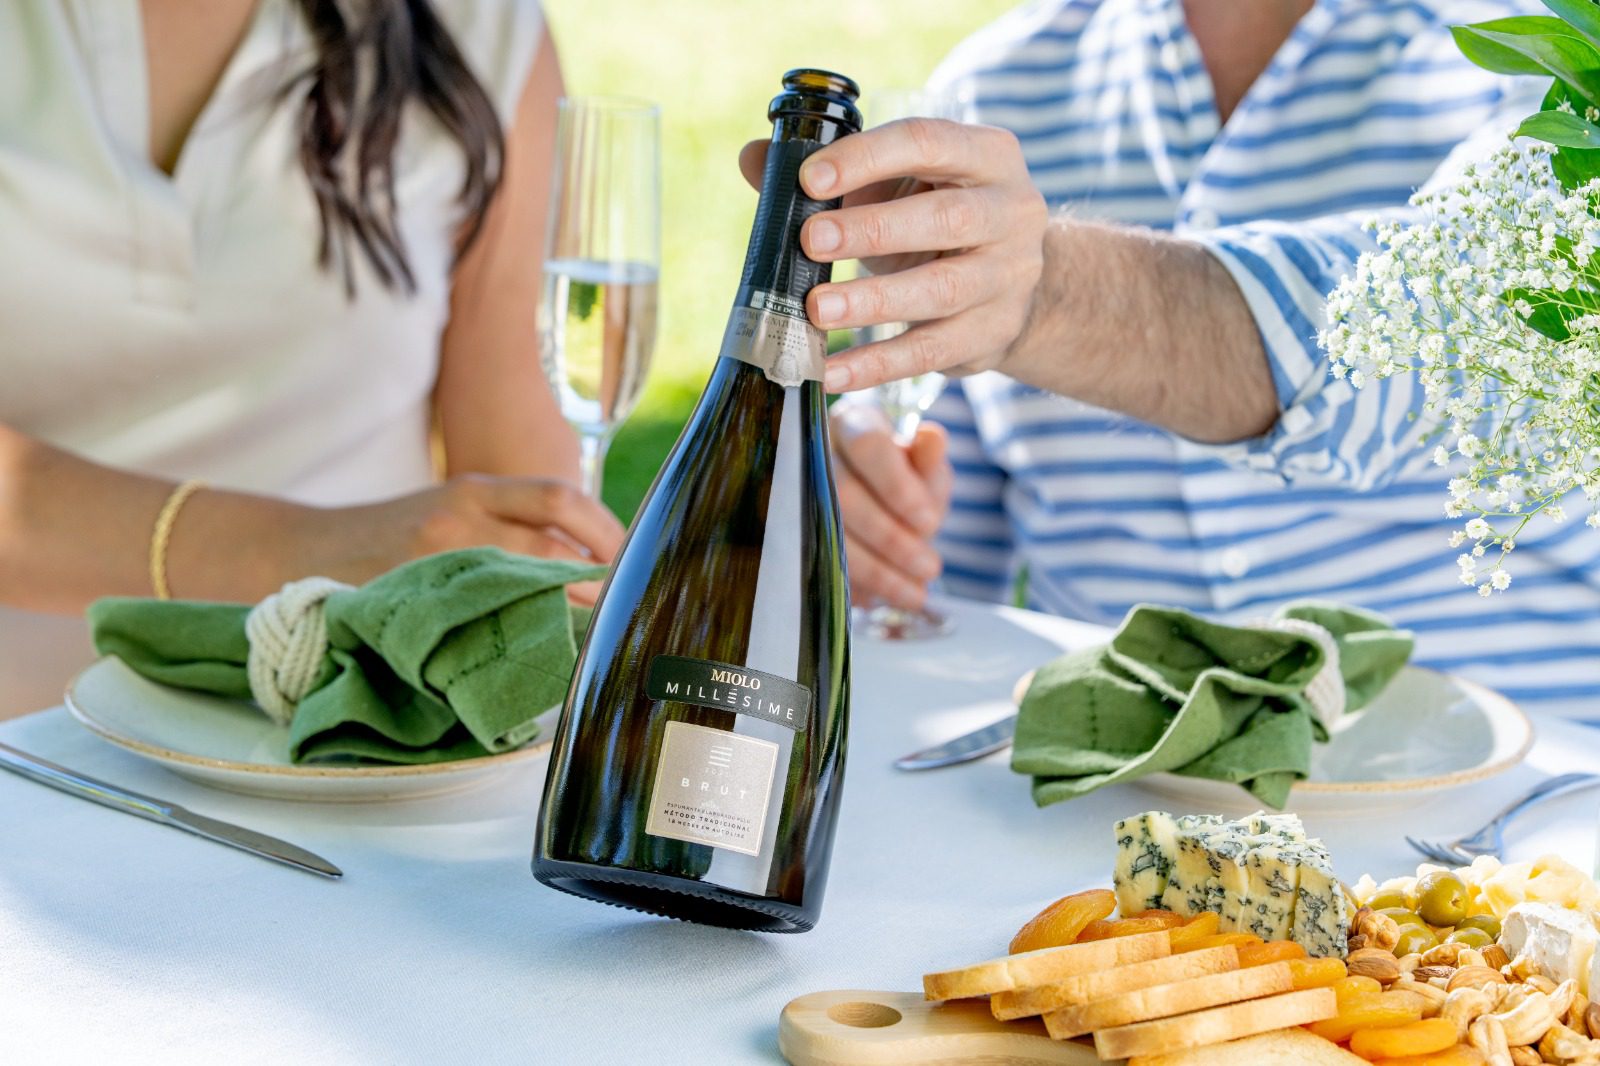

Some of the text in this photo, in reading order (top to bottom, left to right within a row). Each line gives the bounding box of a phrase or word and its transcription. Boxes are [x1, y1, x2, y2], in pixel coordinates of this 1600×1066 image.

[765, 301, 782, 312] VALE
[783, 307, 798, 315] DOS
[711, 669, 760, 690] MIOLO
[681, 777, 747, 800] BRUT
[667, 802, 701, 813] ESPUMANTE
[664, 809, 751, 833] MÉTODO TRADICIONAL
[677, 821, 699, 829] MESES
